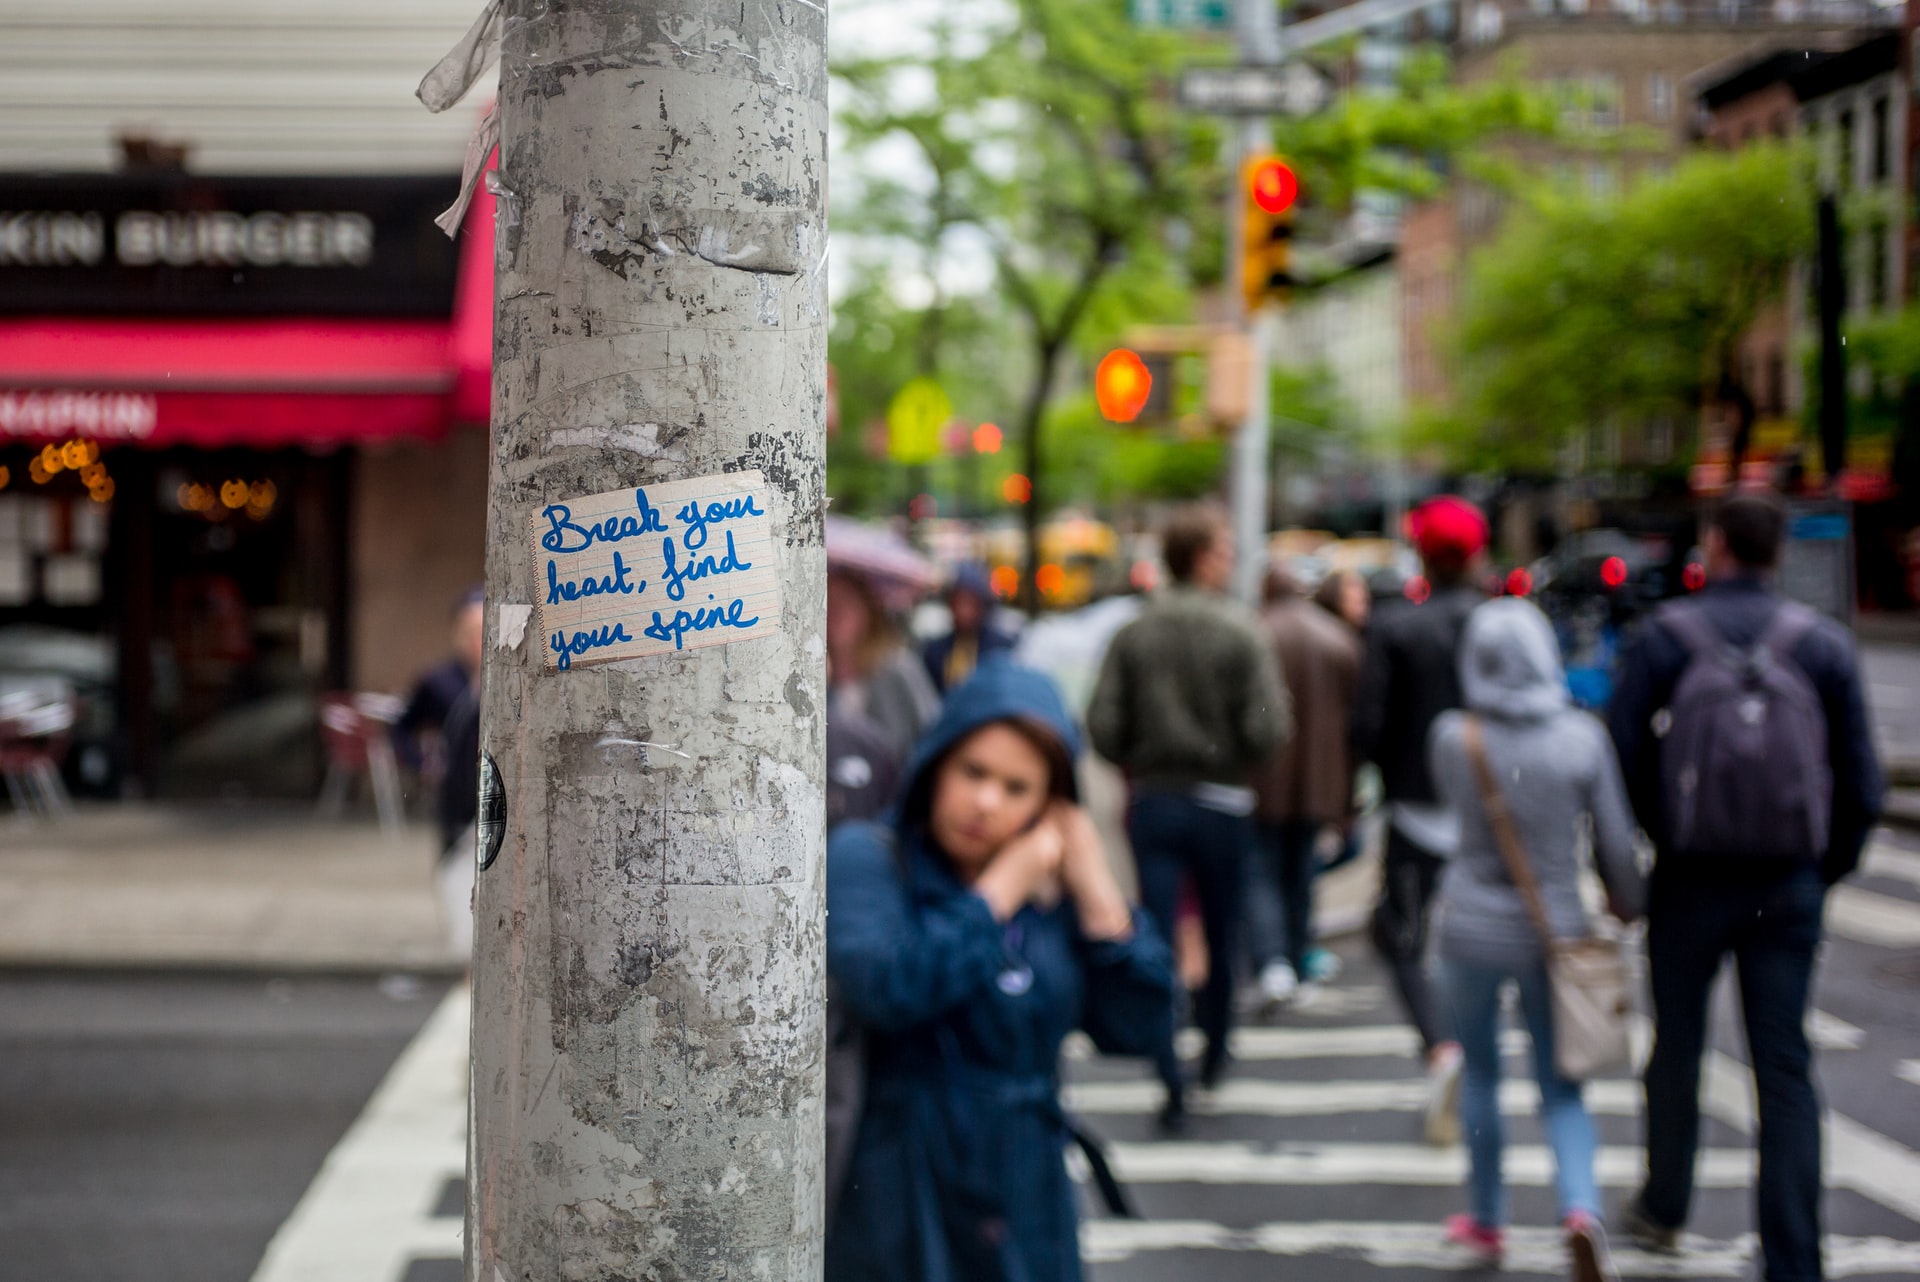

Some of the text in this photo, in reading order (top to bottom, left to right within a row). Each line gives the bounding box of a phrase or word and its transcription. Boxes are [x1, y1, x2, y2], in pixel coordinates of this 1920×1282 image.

[116, 211, 374, 267] BURGER
[542, 488, 764, 553] Break your
[547, 530, 752, 604] heart, find
[552, 594, 759, 671] your spine
